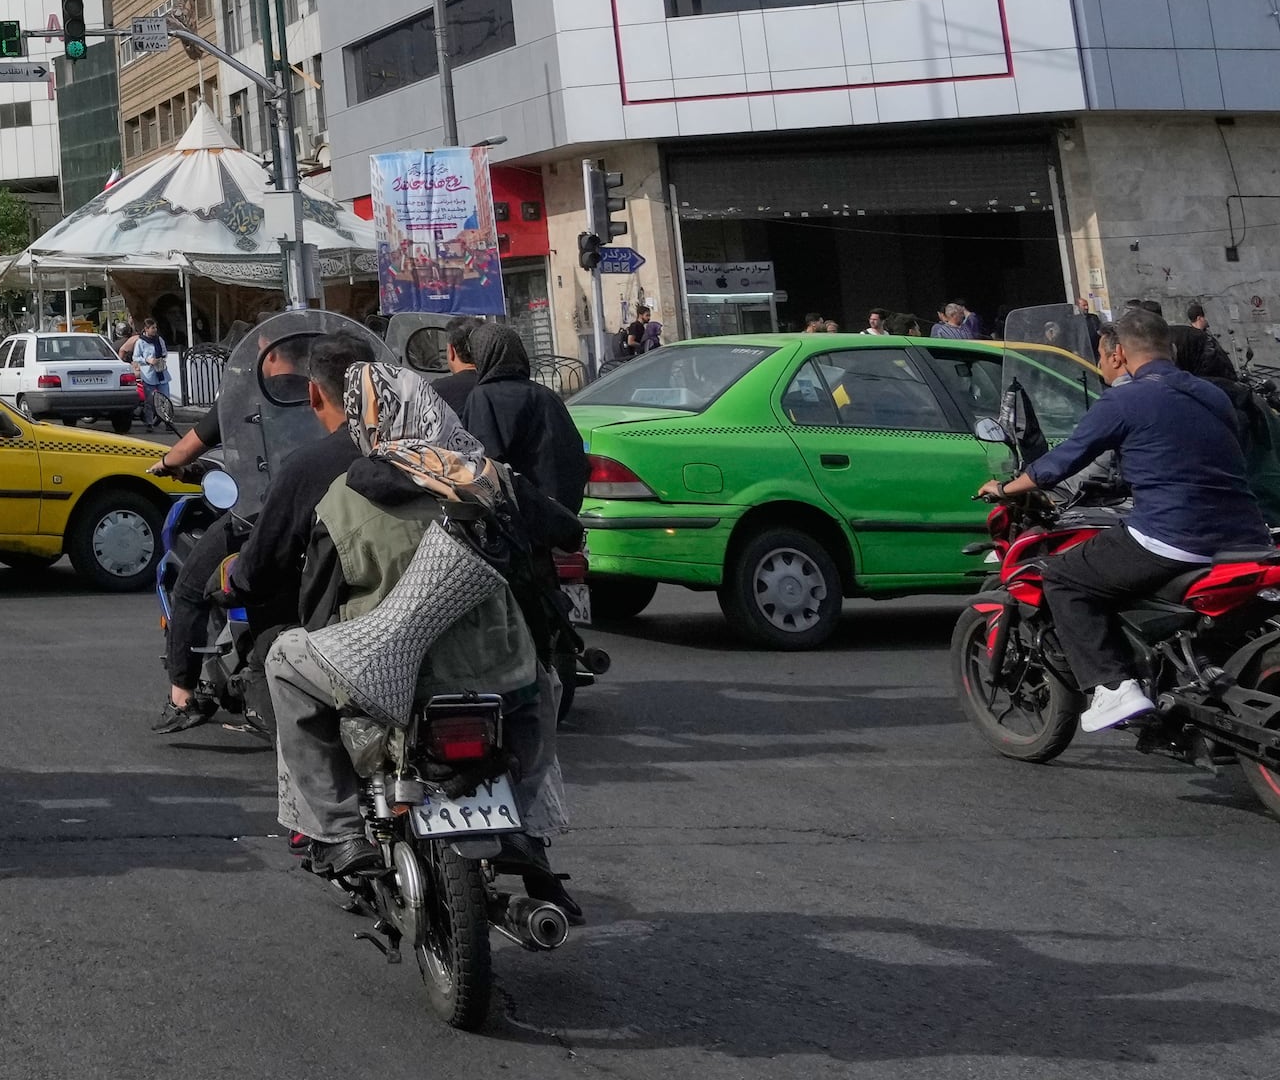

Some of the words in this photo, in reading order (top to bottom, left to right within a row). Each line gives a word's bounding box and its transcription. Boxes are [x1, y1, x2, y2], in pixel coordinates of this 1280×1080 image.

[603, 249, 632, 261] زیرگذر
[745, 264, 770, 274] لوازم
[420, 804, 518, 832] ۲۹۴۲۹
